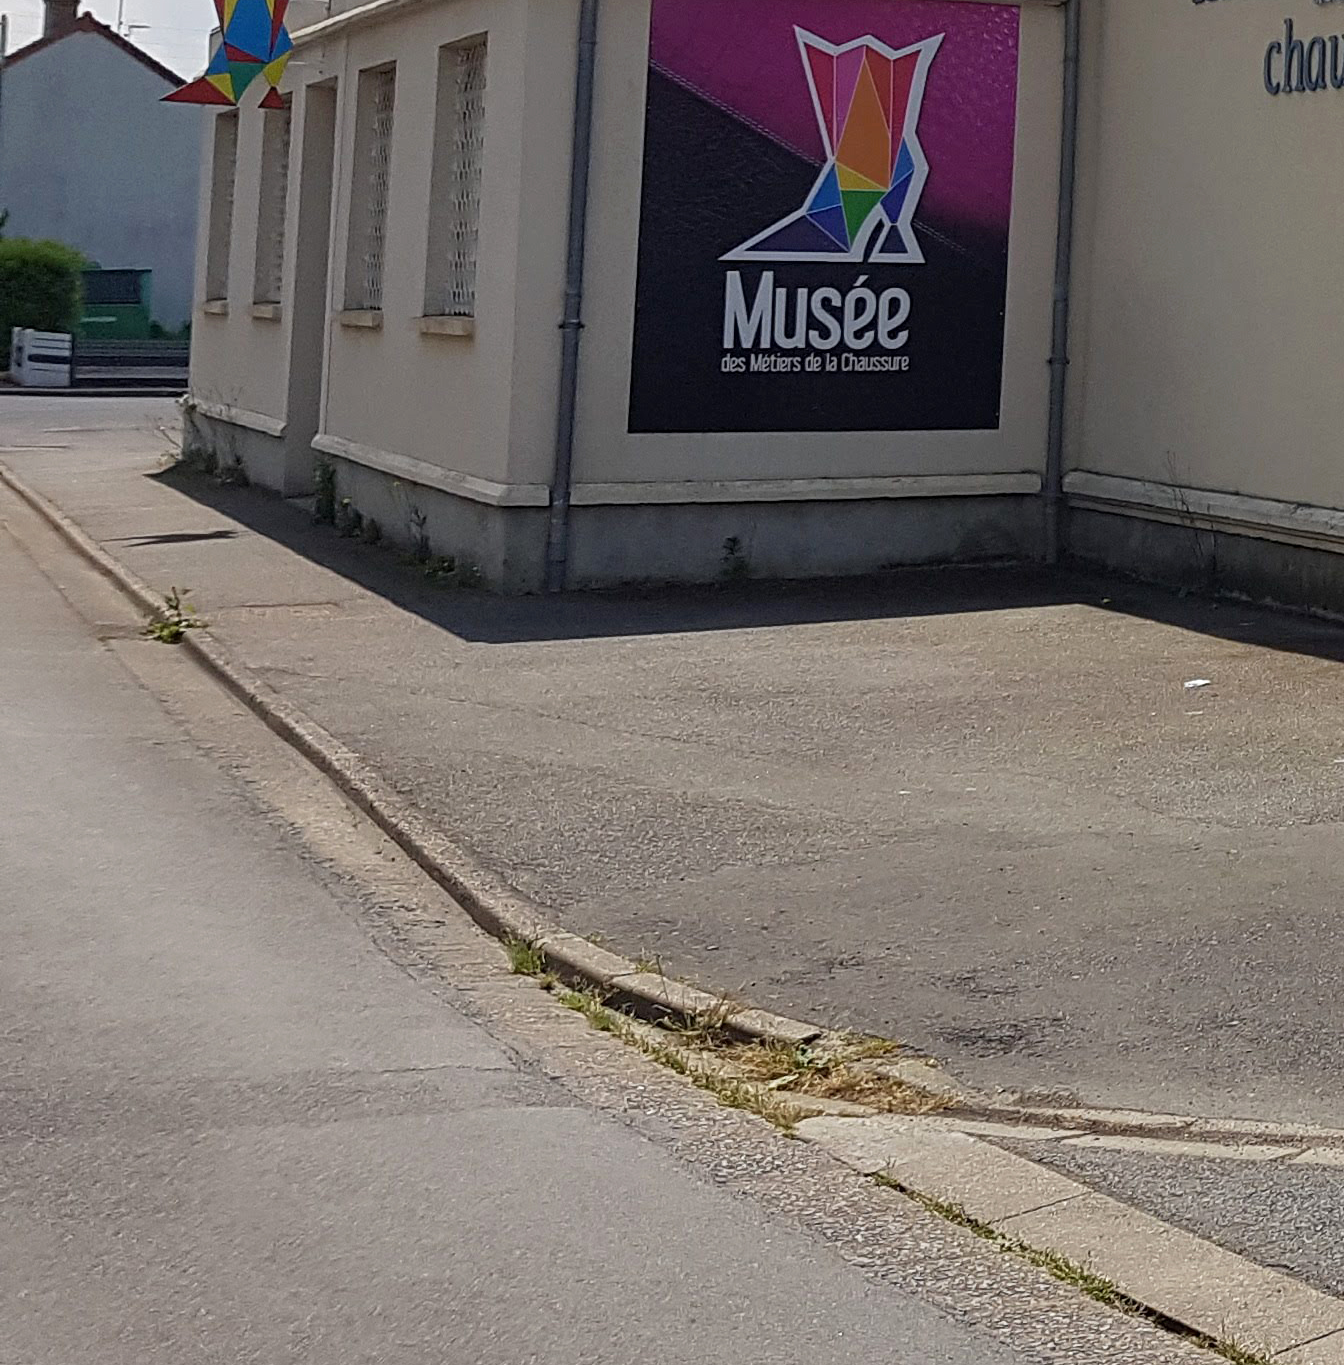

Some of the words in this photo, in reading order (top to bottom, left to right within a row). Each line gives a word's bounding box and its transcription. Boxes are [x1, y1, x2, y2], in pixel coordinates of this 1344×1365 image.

[723, 270, 911, 350] Musée
[720, 354, 746, 373] des
[750, 353, 801, 373] Métiers
[805, 353, 822, 373] de
[825, 353, 838, 372] la
[841, 353, 910, 372] Chaussure
